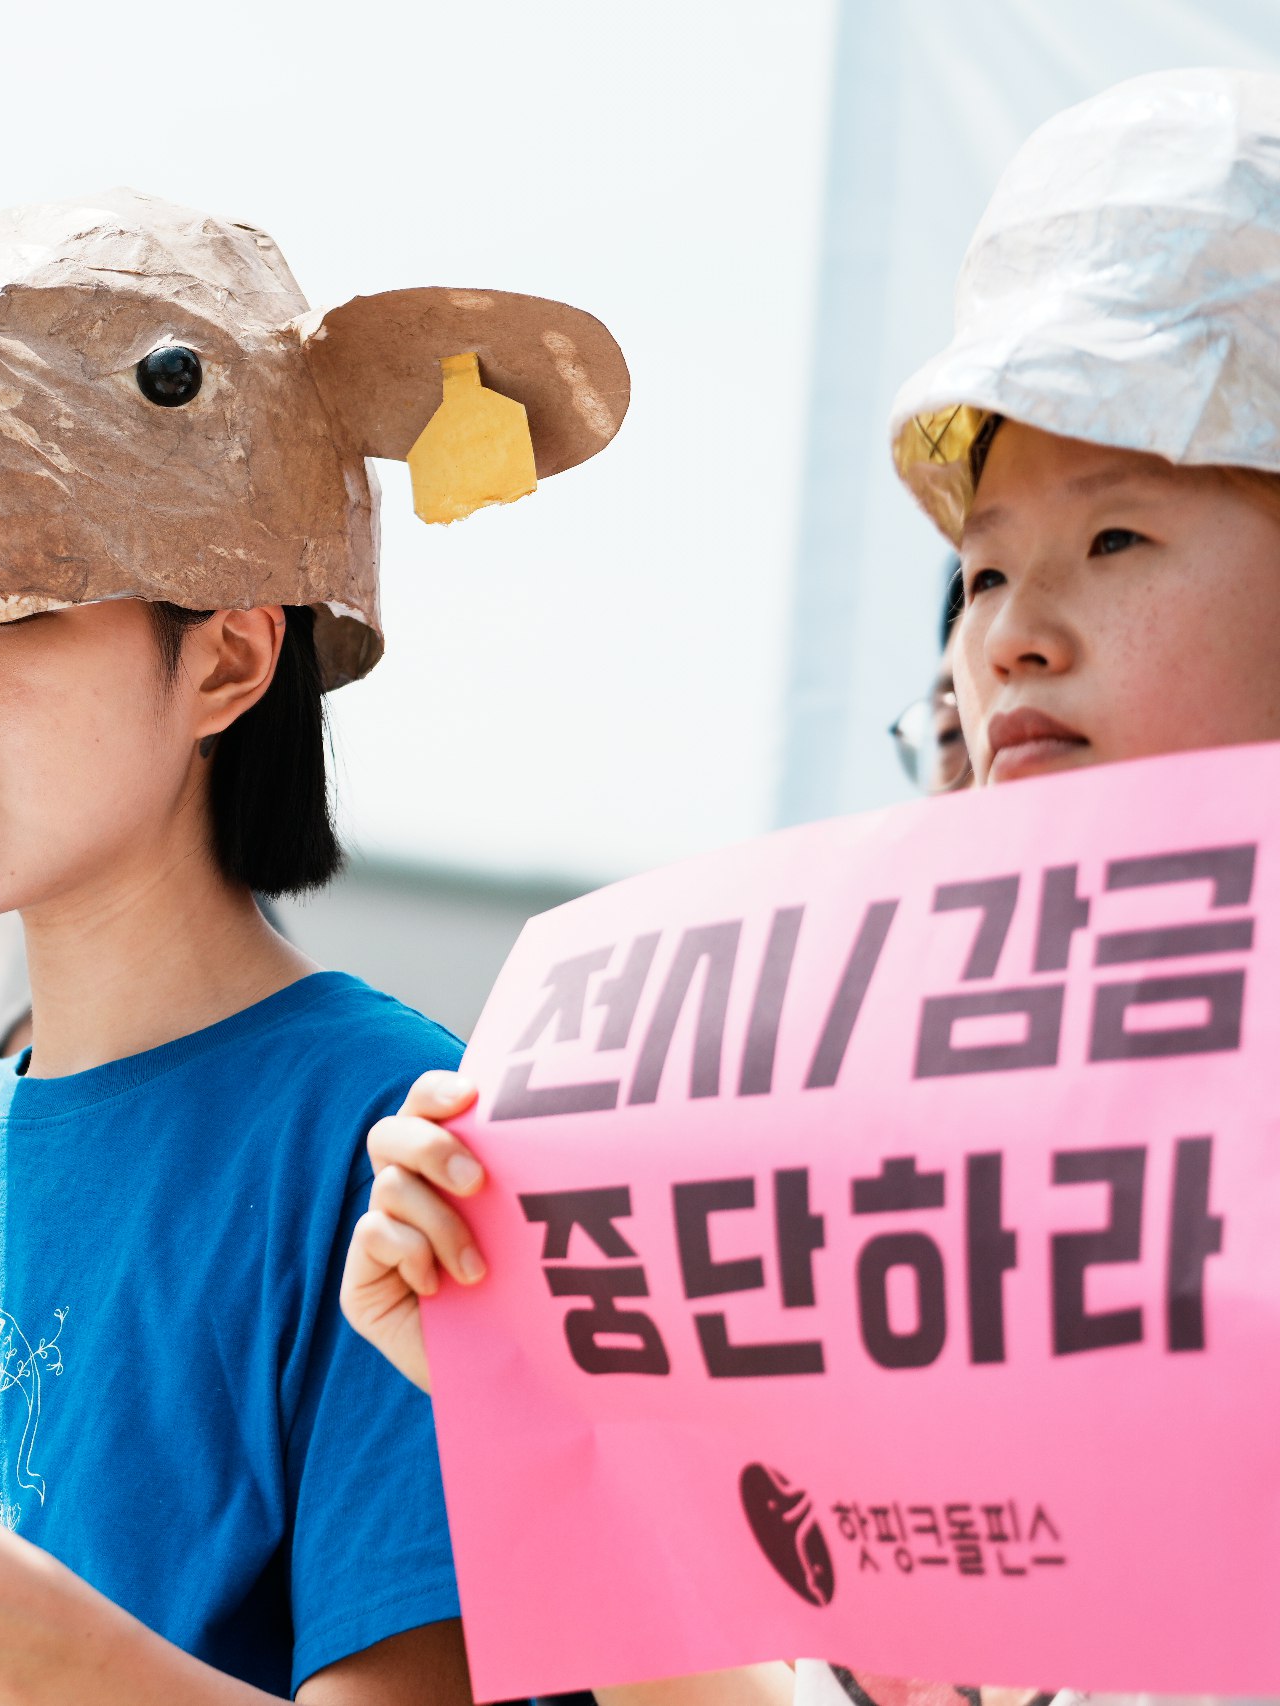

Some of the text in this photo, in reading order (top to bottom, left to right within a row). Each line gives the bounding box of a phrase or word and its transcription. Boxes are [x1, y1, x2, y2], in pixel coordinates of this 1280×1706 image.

[488, 843, 1258, 1123] 전시/감금
[516, 1134, 1225, 1380] 중단하라
[831, 1502, 1067, 1577] 핫핑크돌핀스
